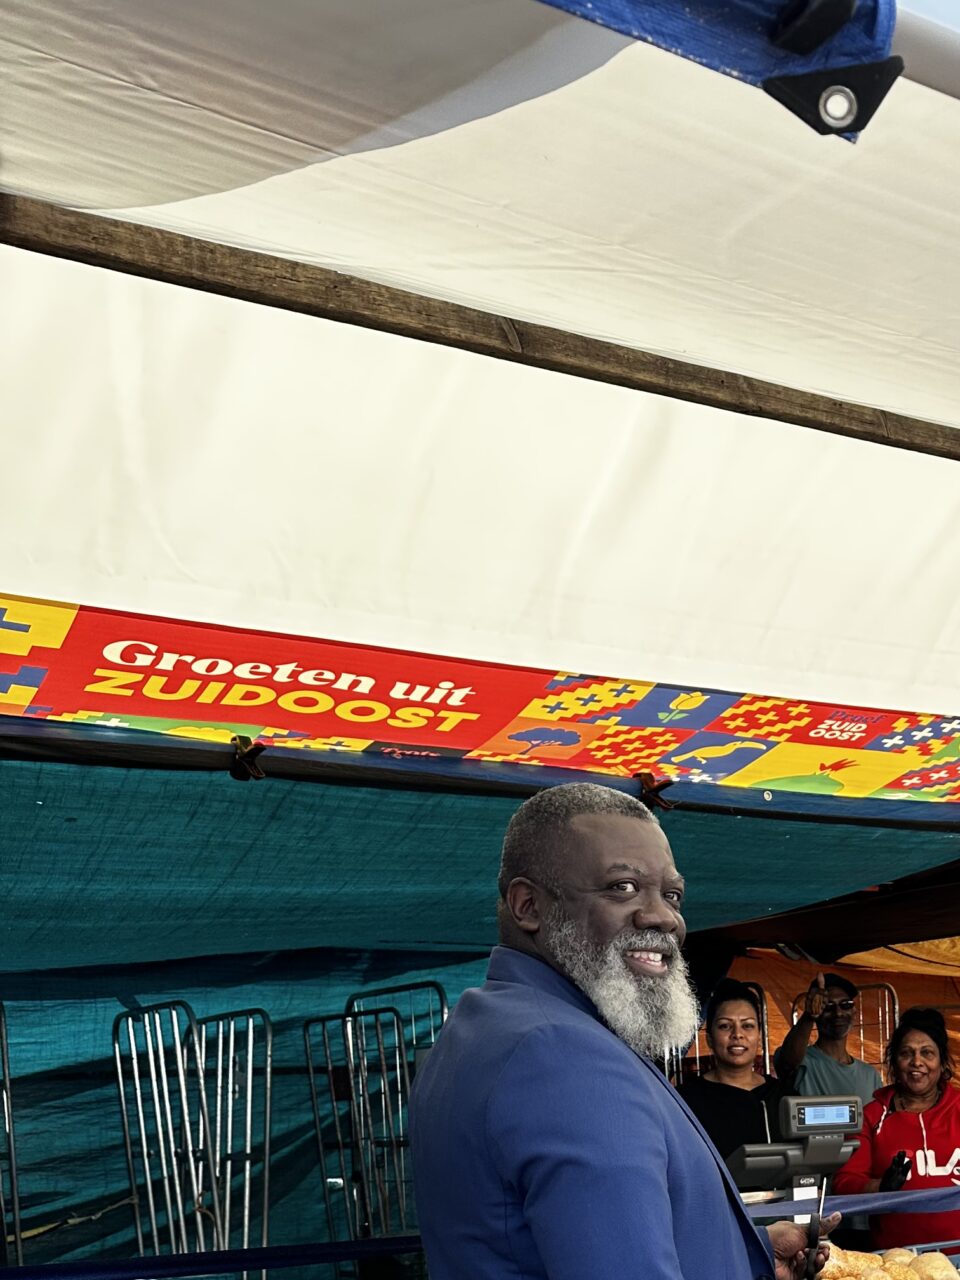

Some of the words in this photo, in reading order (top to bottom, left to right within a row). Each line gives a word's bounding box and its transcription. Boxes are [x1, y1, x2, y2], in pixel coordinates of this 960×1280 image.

[102, 640, 376, 694] Groeten
[389, 681, 477, 706] uit
[83, 667, 481, 732] ZUIDOOST
[808, 728, 867, 742] OOST
[816, 719, 868, 732] ZUID
